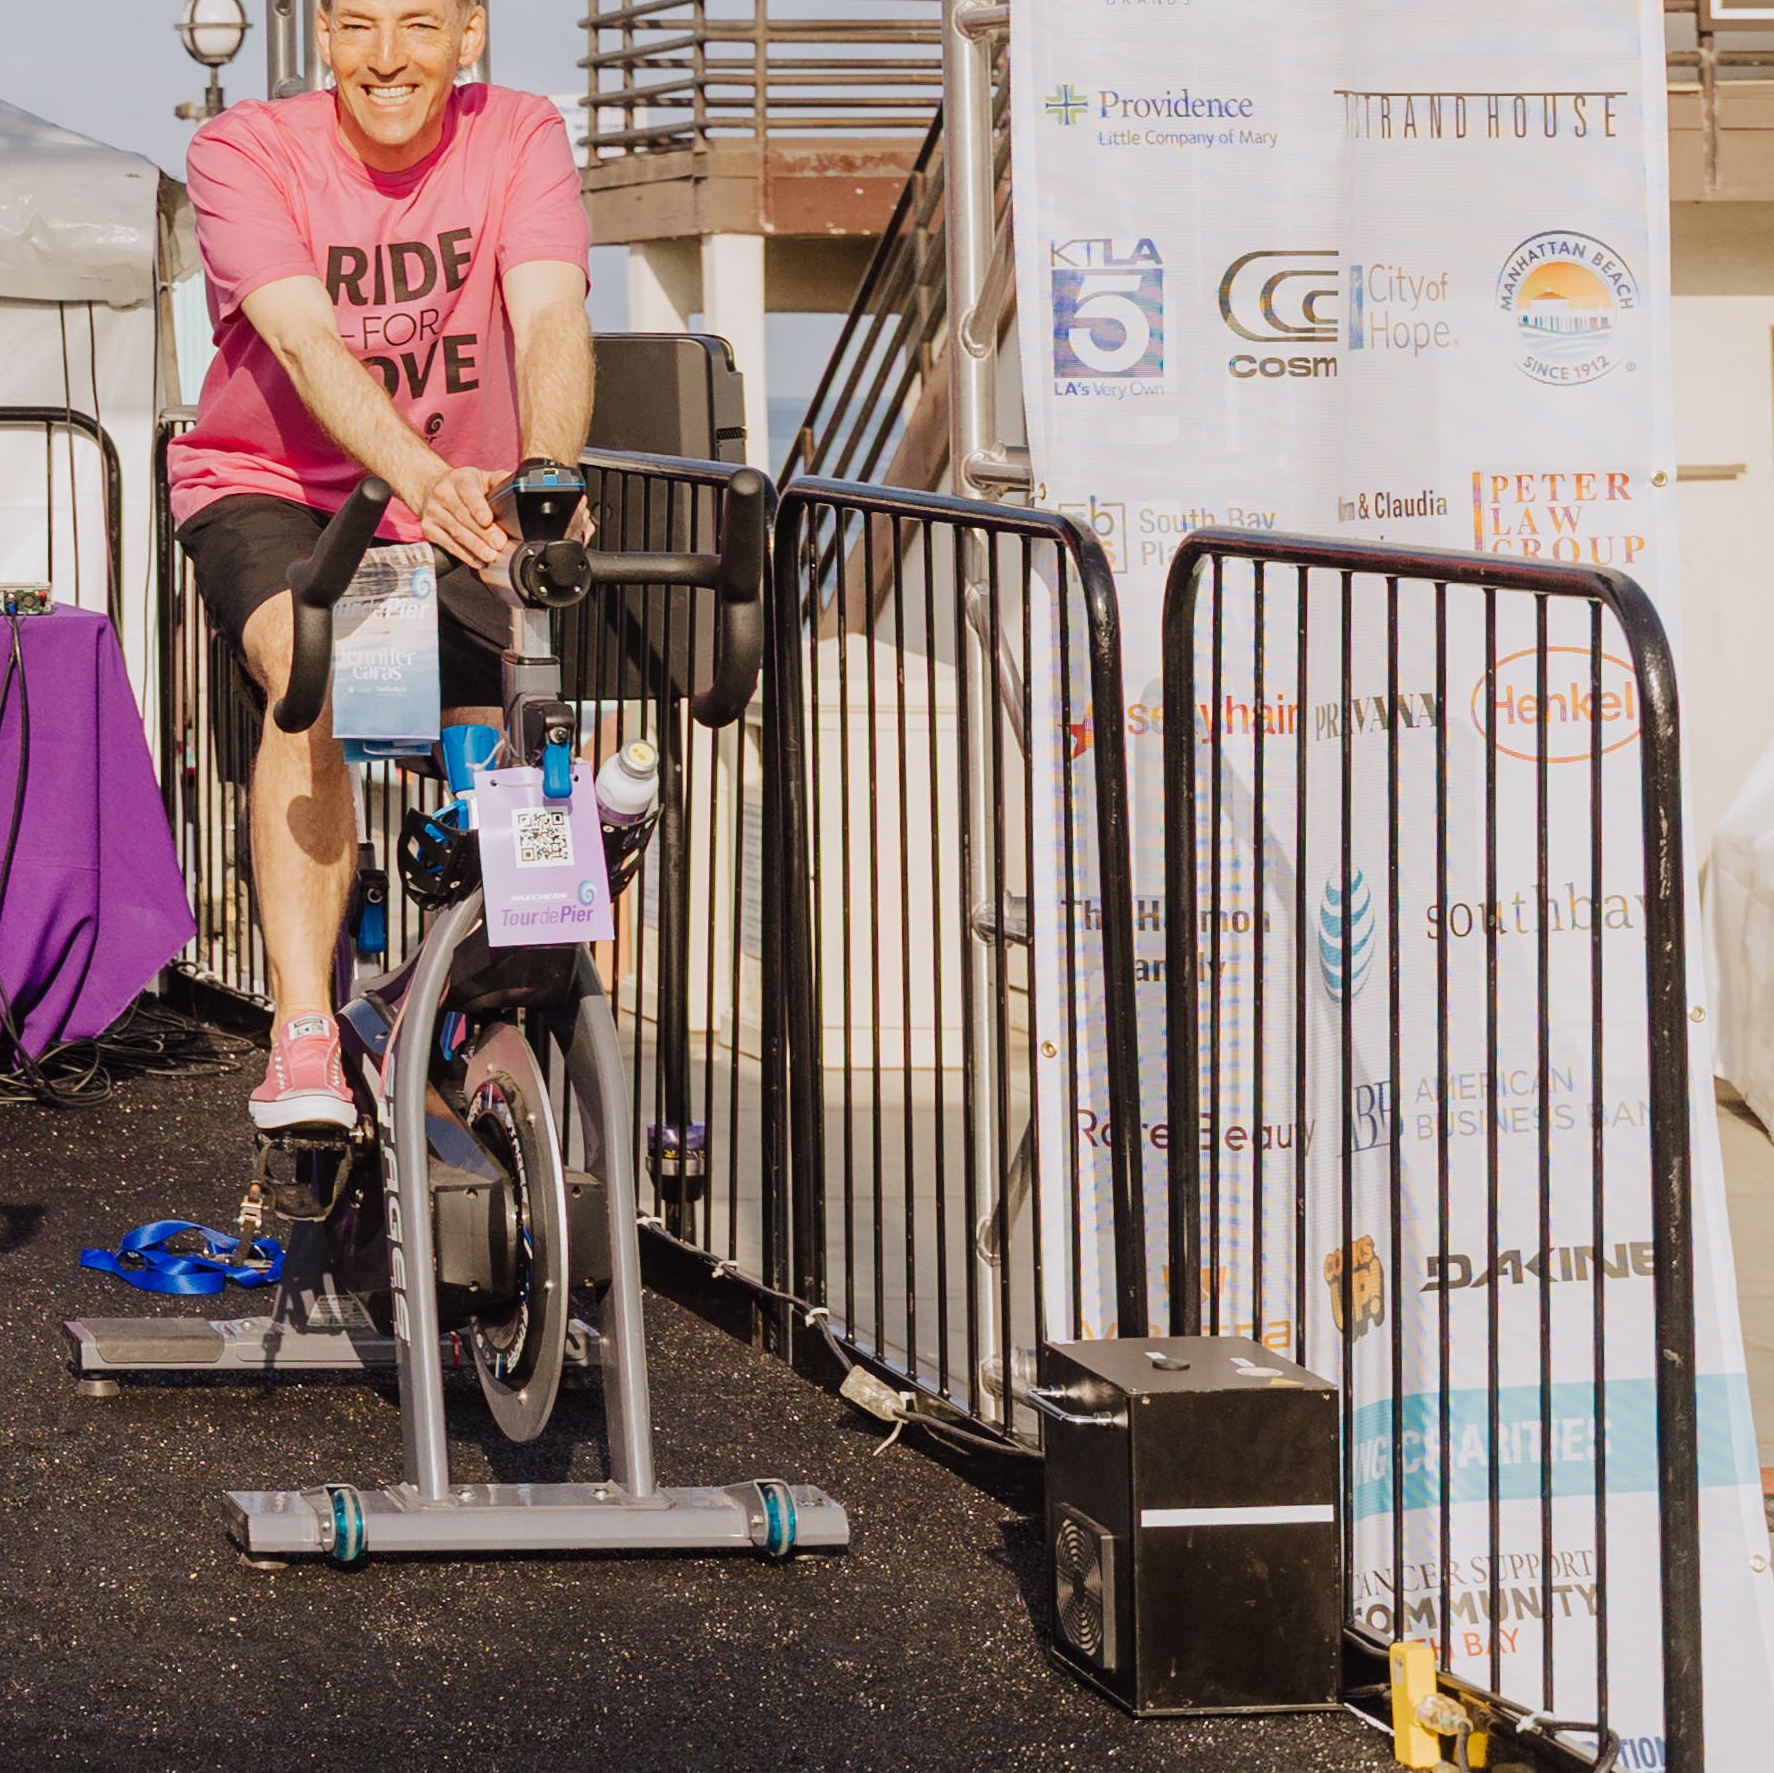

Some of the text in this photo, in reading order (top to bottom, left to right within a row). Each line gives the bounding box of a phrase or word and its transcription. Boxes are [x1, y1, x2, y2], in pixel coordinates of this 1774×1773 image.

[1098, 89, 1253, 118] Providence
[1098, 129, 1278, 148] Little Company of Mary
[326, 227, 474, 306] RIDE
[1051, 238, 1163, 267] KTLA
[1368, 264, 1449, 311] City of
[1500, 241, 1634, 311] MANHATTAN BEACH
[363, 308, 441, 350] FOR
[1068, 275, 1150, 373] 5
[358, 333, 479, 400] OVE
[1524, 355, 1610, 379] SINCE 1912
[1054, 381, 1164, 400] LA's Very Own
[1490, 473, 1632, 504] PETER
[1358, 497, 1370, 520] &
[1374, 490, 1447, 519] Claudia
[1139, 508, 1215, 534] South
[1492, 506, 1582, 536] LAW
